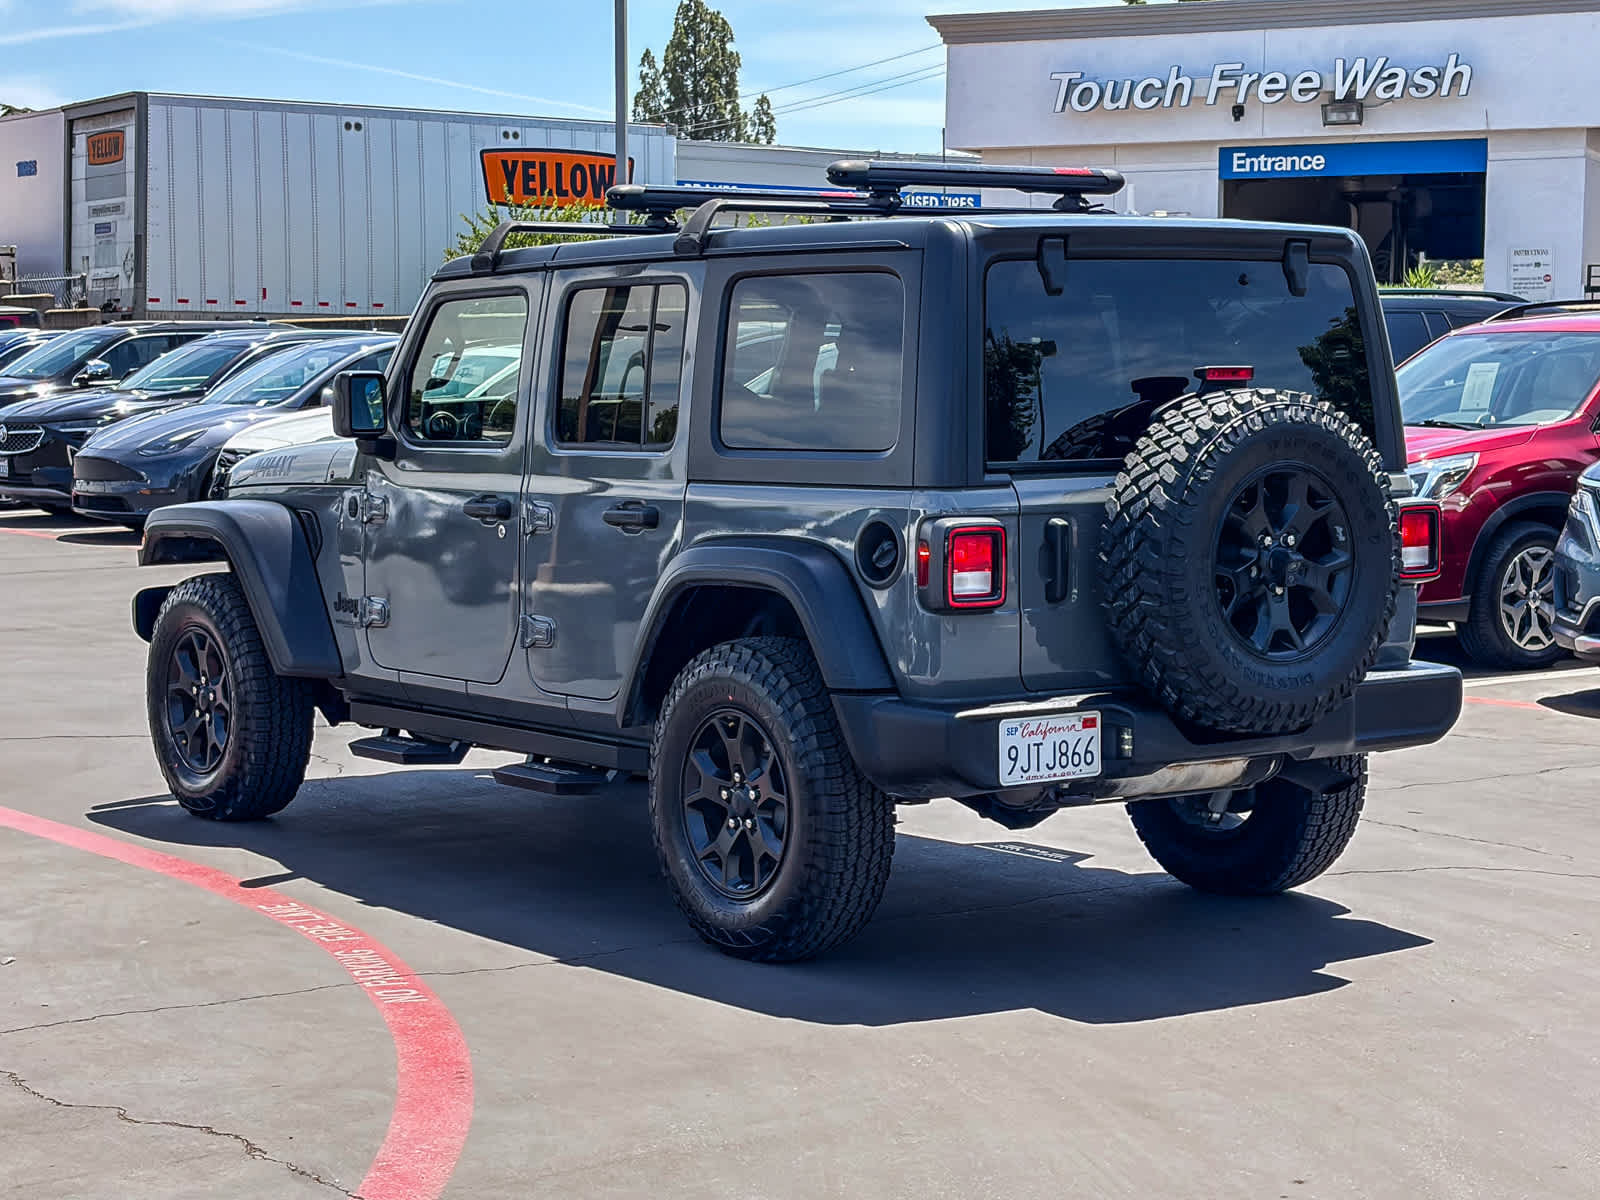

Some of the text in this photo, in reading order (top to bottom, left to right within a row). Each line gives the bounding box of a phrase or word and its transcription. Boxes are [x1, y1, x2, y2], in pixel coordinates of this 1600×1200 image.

[1049, 53, 1473, 113] Touch Free Wash
[91, 135, 120, 160] YELLOW
[1232, 152, 1326, 174] Entrance
[500, 159, 617, 198] YELLOW
[333, 591, 359, 618] Jeep
[1006, 727, 1018, 736] SEP
[1021, 720, 1082, 740] California
[1007, 735, 1095, 776] 9JTJ866
[257, 902, 429, 1004] NO PARKING FIRE LANE
